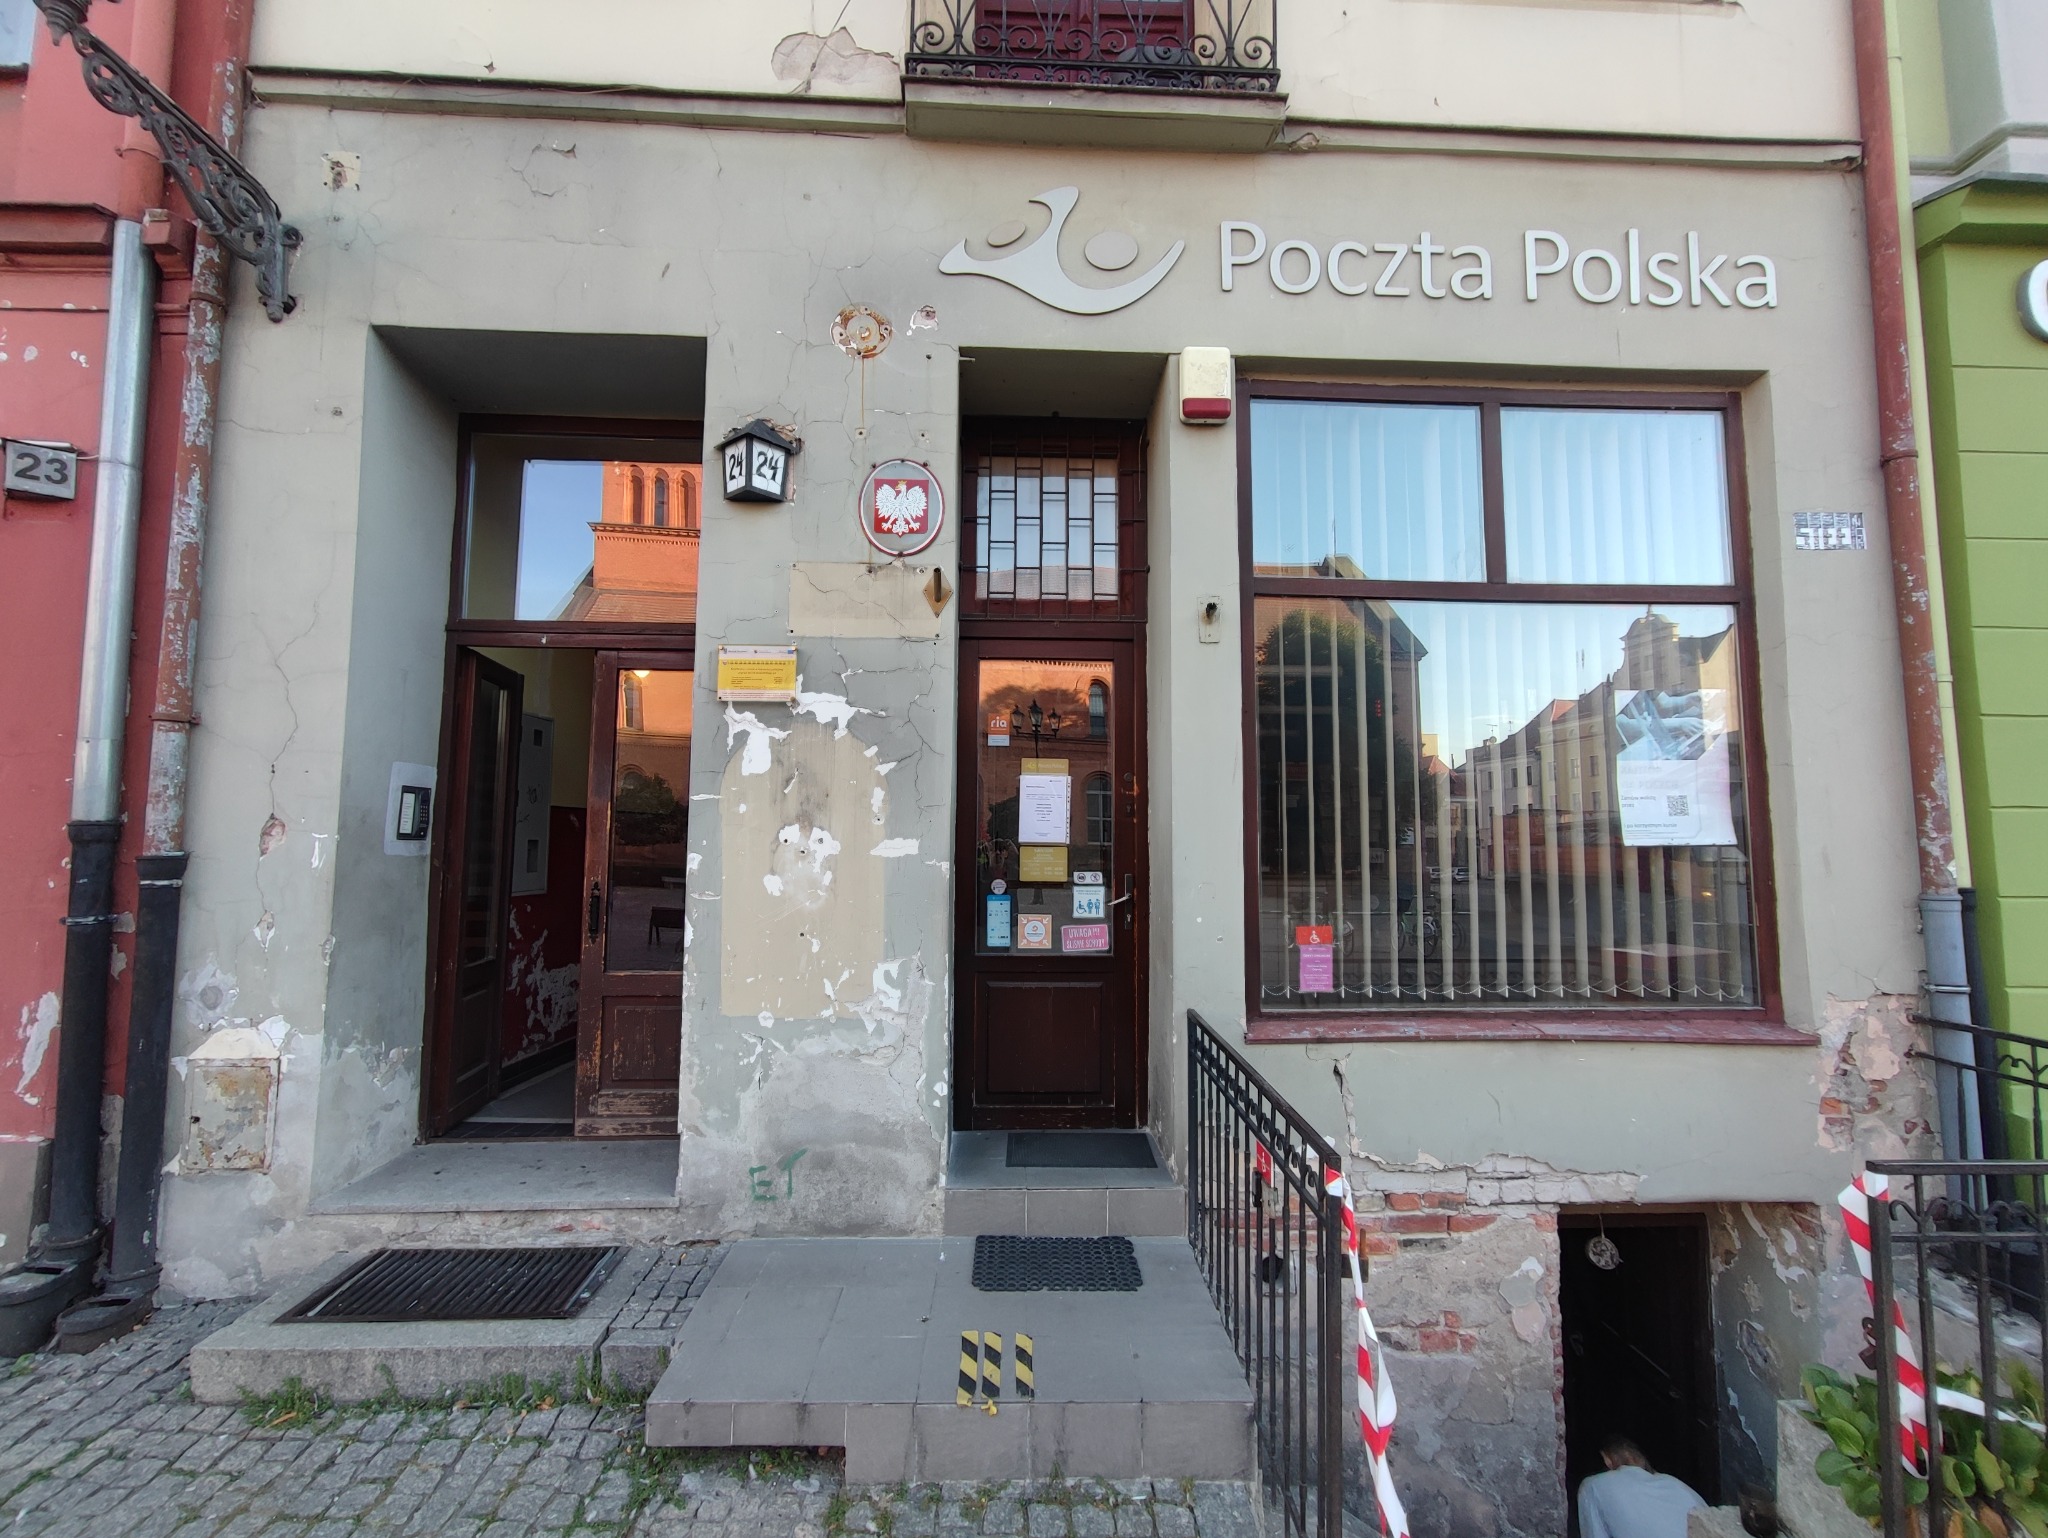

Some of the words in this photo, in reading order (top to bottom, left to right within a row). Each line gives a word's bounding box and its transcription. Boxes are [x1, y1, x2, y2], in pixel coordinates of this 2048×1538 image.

[1219, 219, 1493, 300] Poczta
[1523, 227, 1778, 310] Polska
[14, 452, 69, 485] 23
[728, 451, 744, 481] 24
[756, 450, 779, 482] 24
[991, 715, 1007, 728] ria
